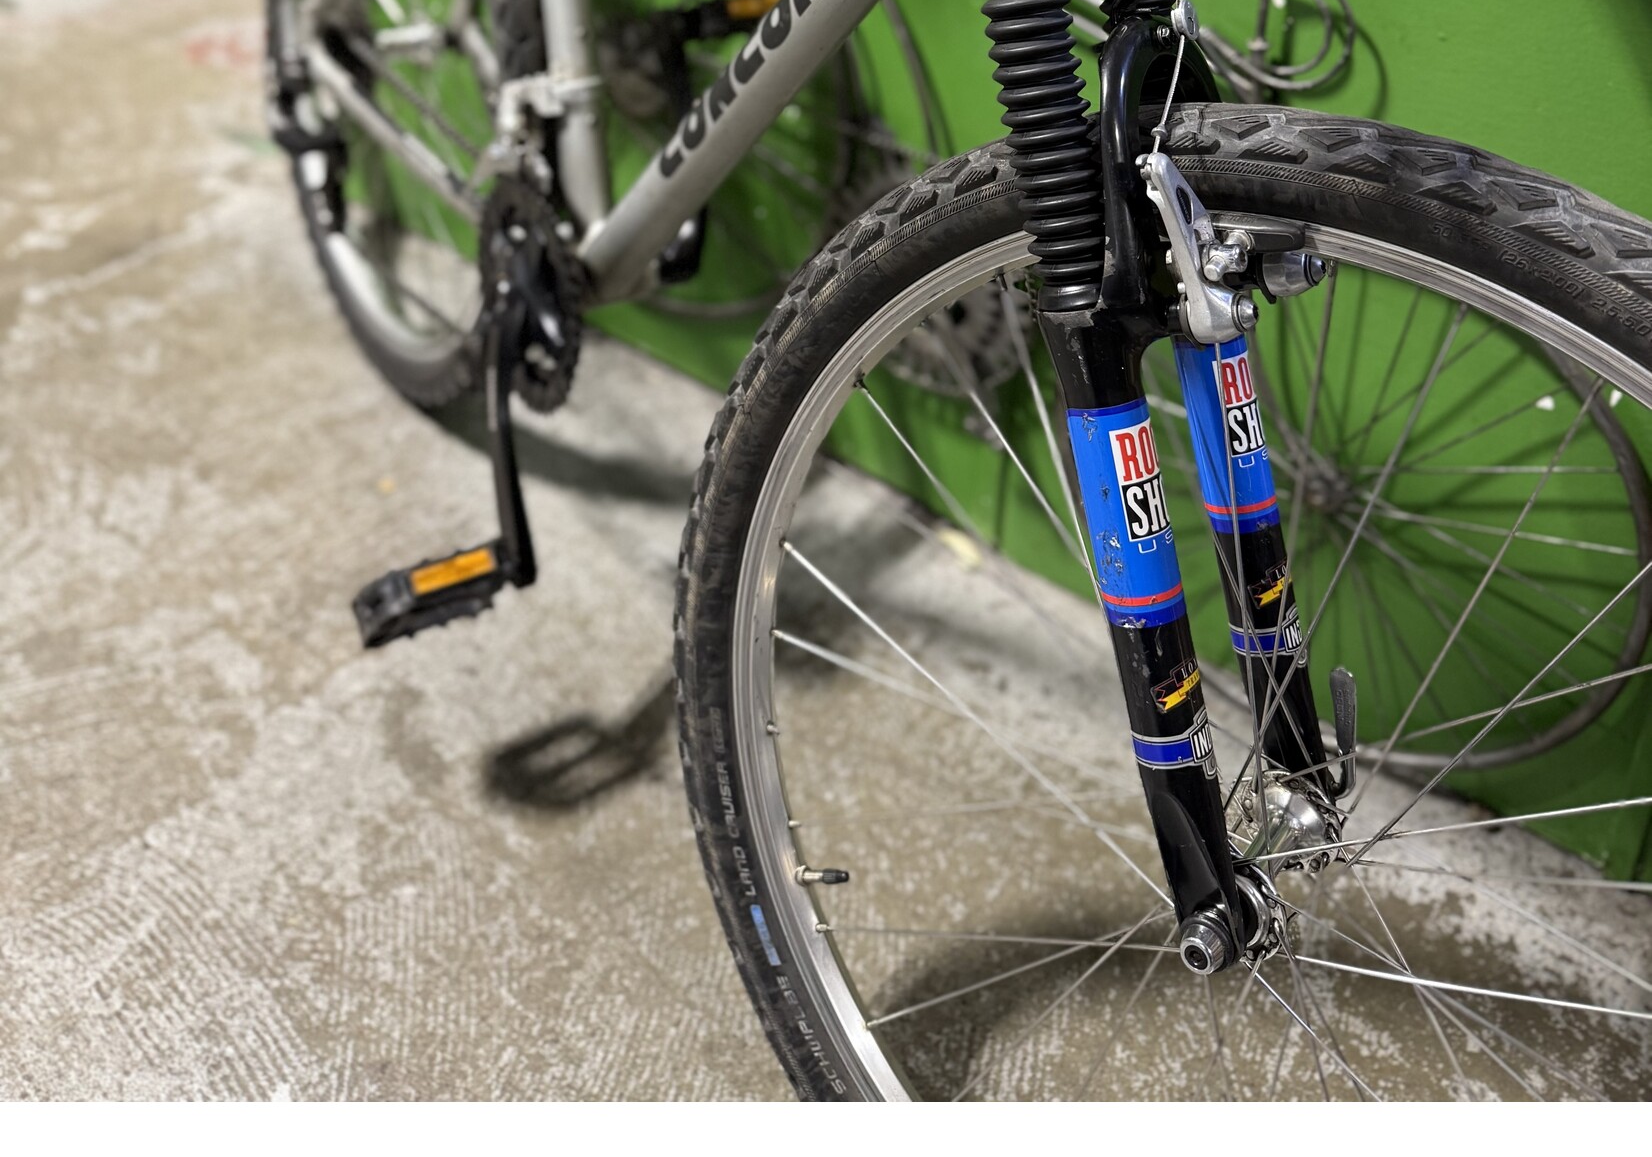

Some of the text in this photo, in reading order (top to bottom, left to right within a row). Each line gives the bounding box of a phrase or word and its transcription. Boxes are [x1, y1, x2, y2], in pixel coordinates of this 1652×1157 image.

[1115, 422, 1160, 482] RO
[1227, 401, 1266, 454] SH
[716, 764, 740, 838] CRUISER
[733, 845, 757, 897] LAND
[775, 973, 847, 1096] SCHWALBE
